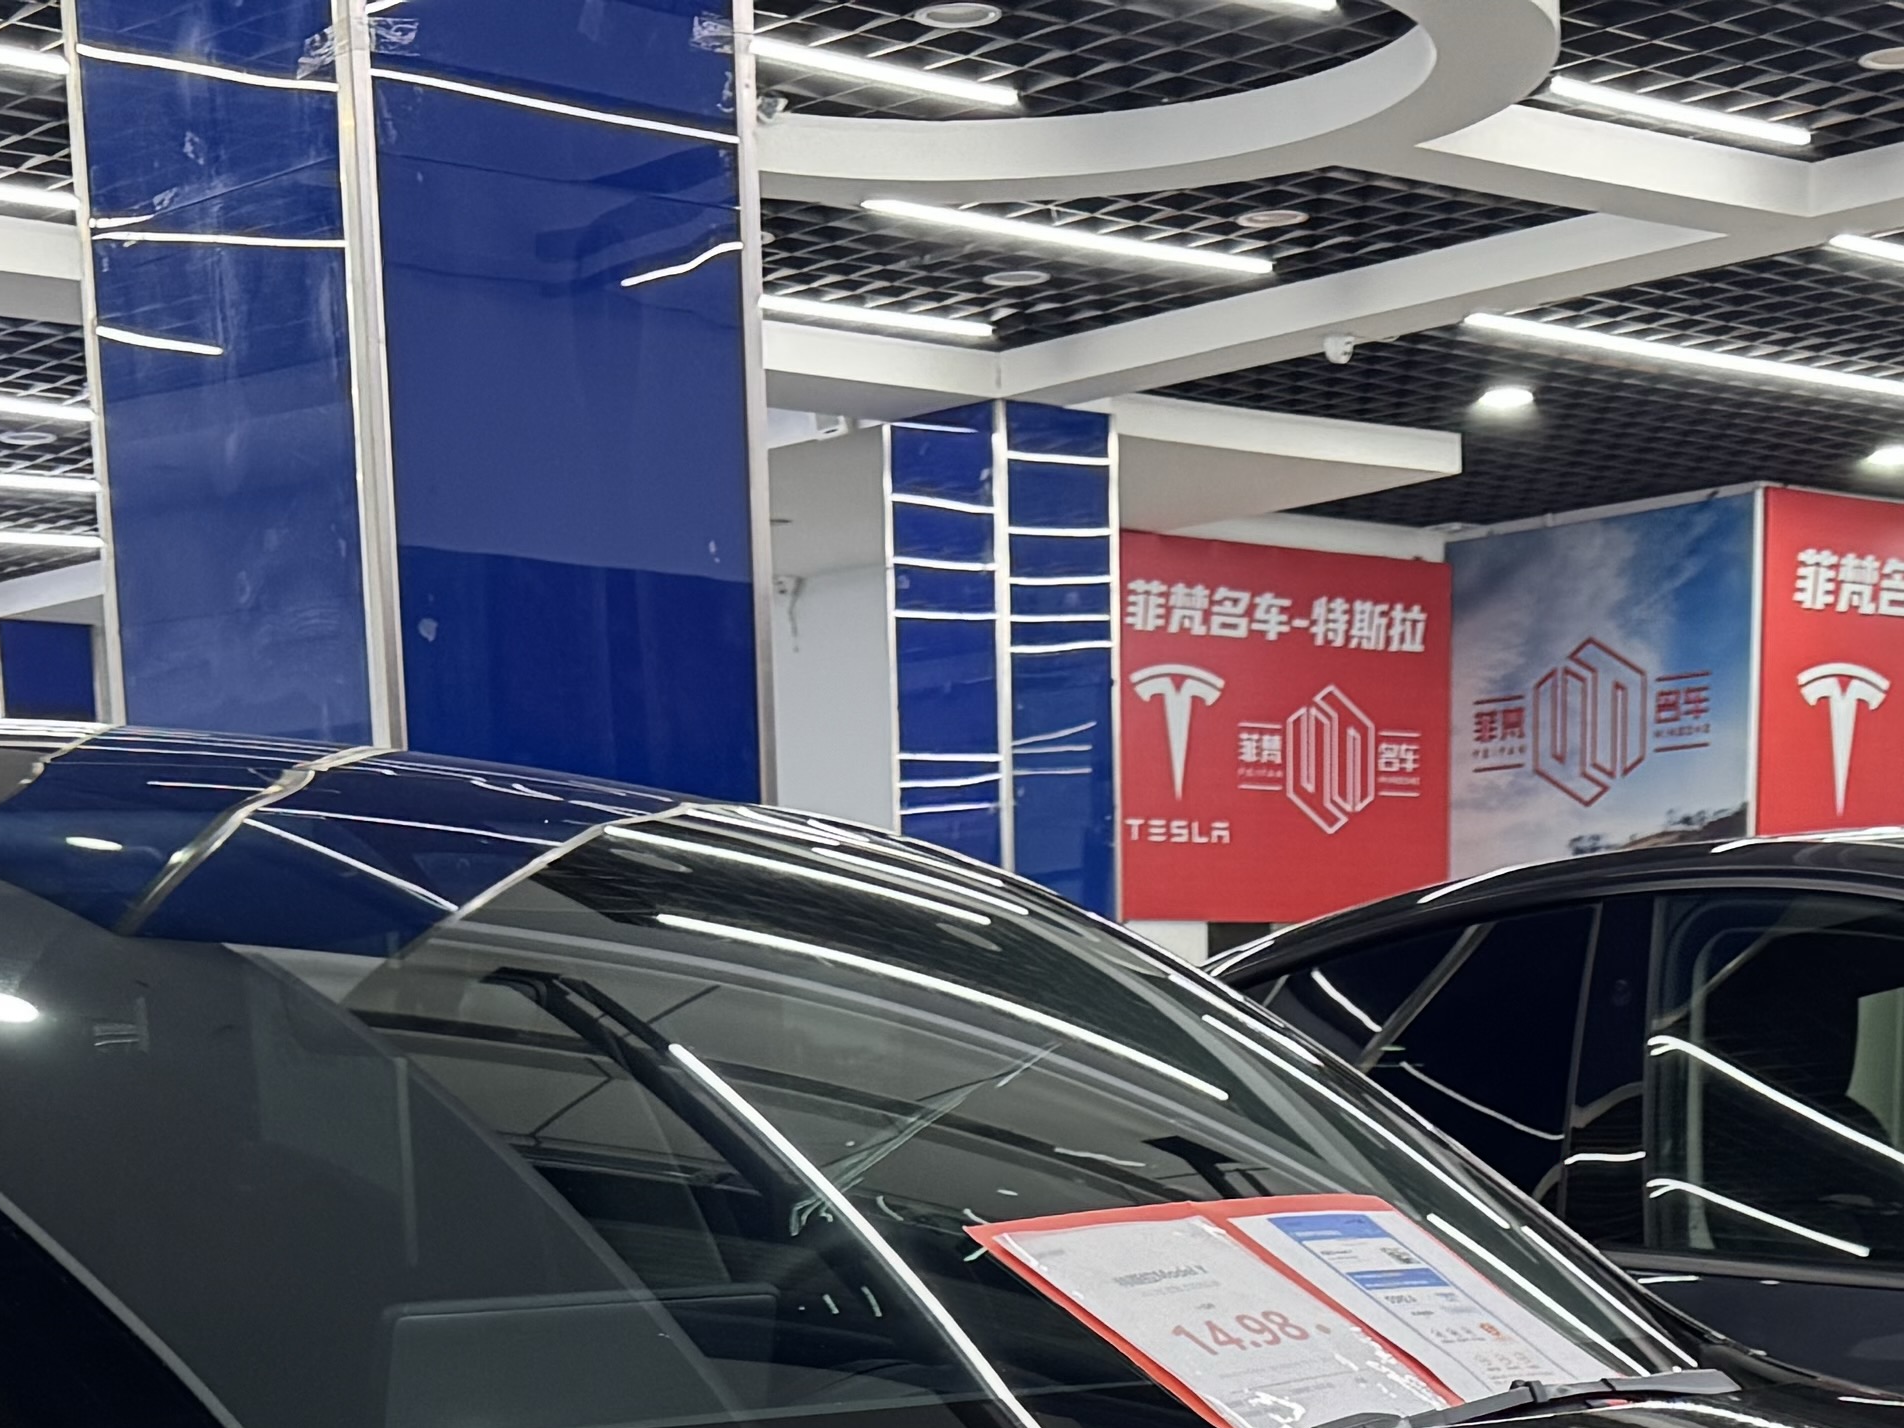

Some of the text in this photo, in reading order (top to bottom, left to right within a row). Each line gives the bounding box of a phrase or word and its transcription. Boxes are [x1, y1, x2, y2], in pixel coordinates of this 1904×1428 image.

[1125, 579, 1427, 652] 菲梵名车-特斯拉
[1125, 818, 1231, 844] TESLA
[1172, 1310, 1310, 1356] 14.98
